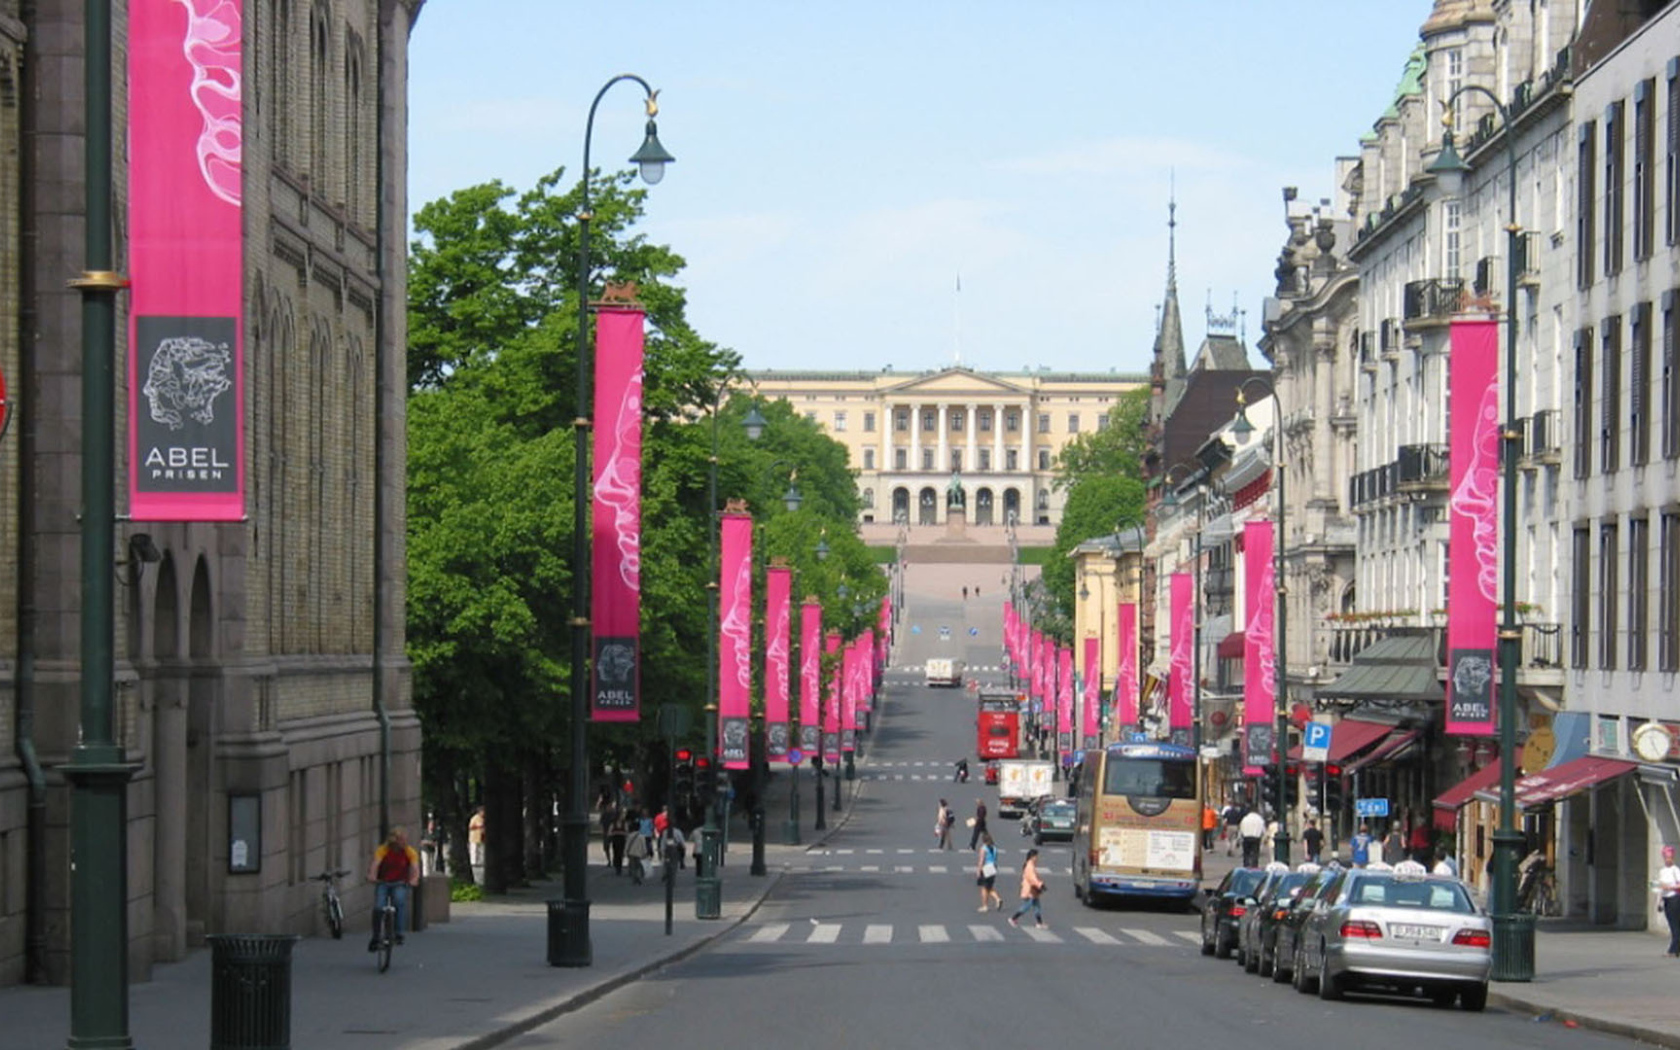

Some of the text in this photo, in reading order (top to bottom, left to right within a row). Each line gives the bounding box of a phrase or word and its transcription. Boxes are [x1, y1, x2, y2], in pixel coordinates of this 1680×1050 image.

[145, 447, 229, 467] ABEL
[152, 469, 222, 479] PRISEN
[597, 690, 633, 700] ABEL
[1453, 703, 1488, 713] ABEL
[1310, 726, 1324, 745] P
